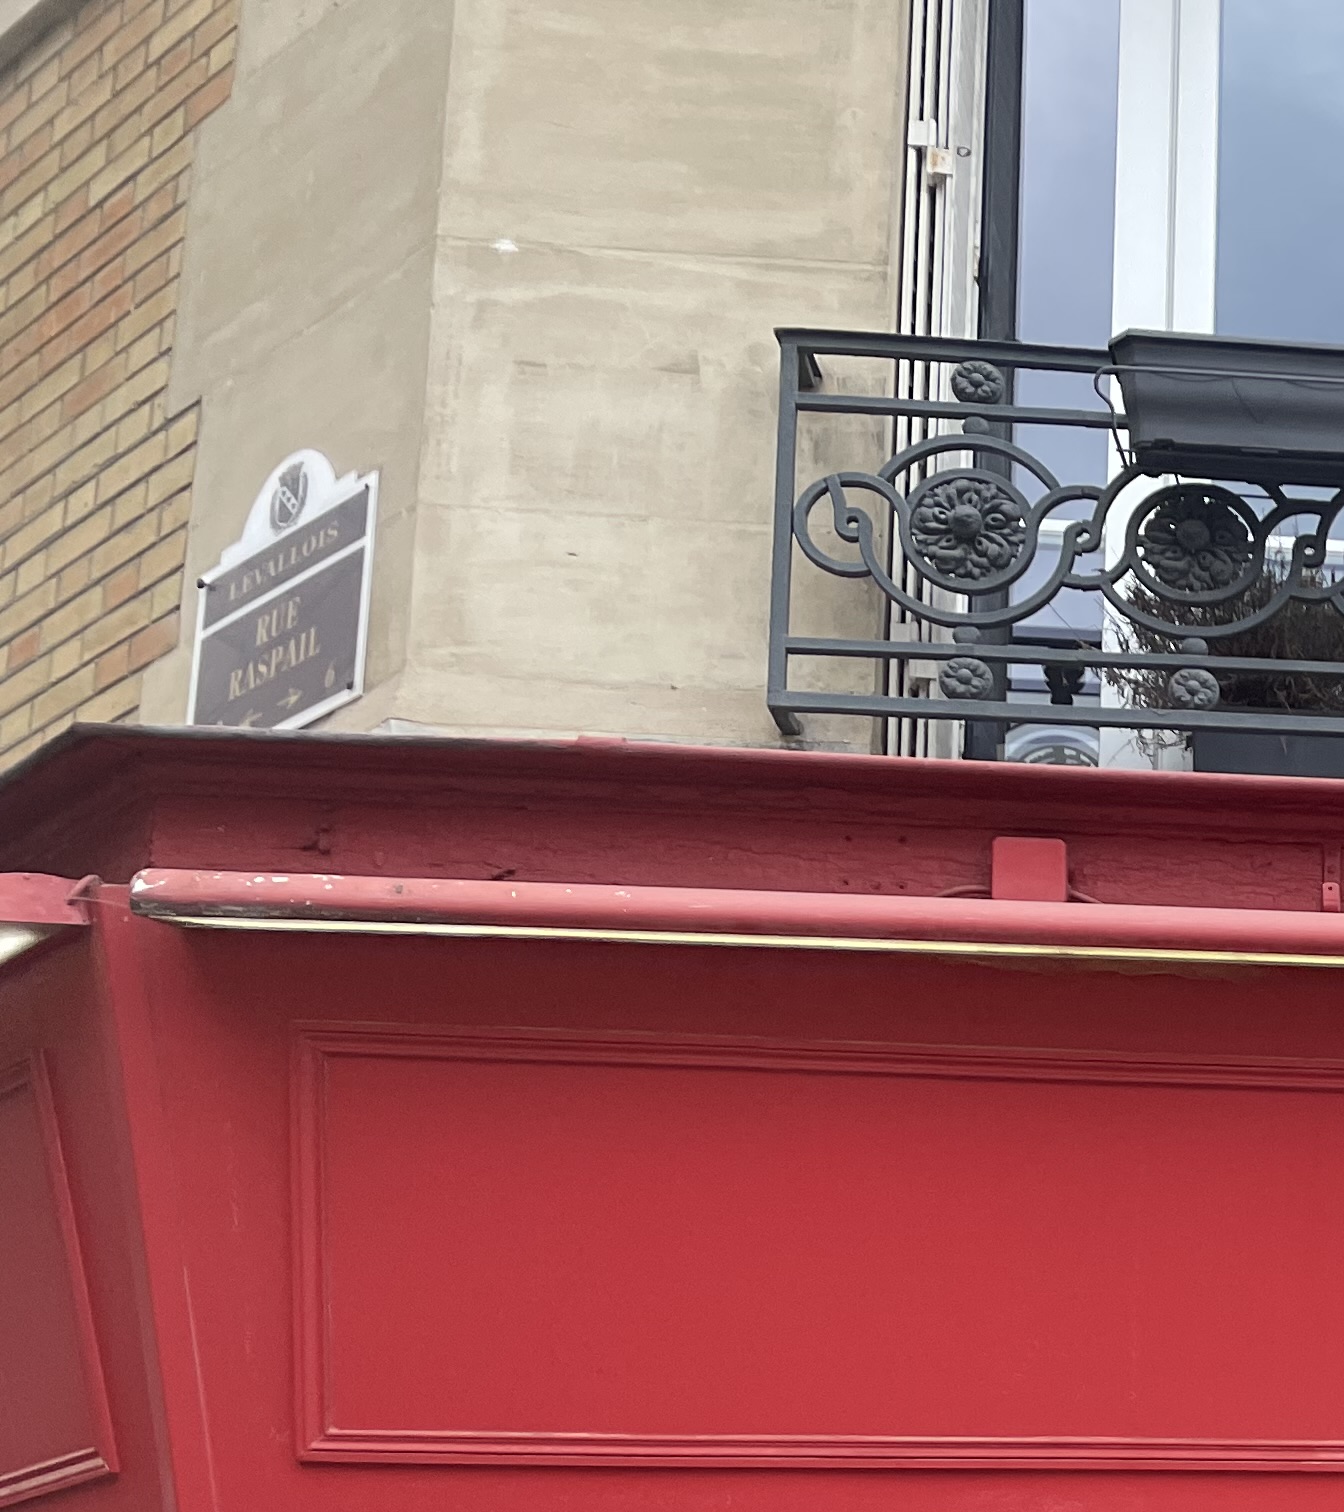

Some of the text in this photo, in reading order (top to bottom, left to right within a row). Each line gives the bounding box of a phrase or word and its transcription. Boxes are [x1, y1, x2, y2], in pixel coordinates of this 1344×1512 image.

[227, 520, 339, 602] LEVALLOIS
[255, 596, 303, 647] RUE
[228, 626, 321, 702] RASPAIL
